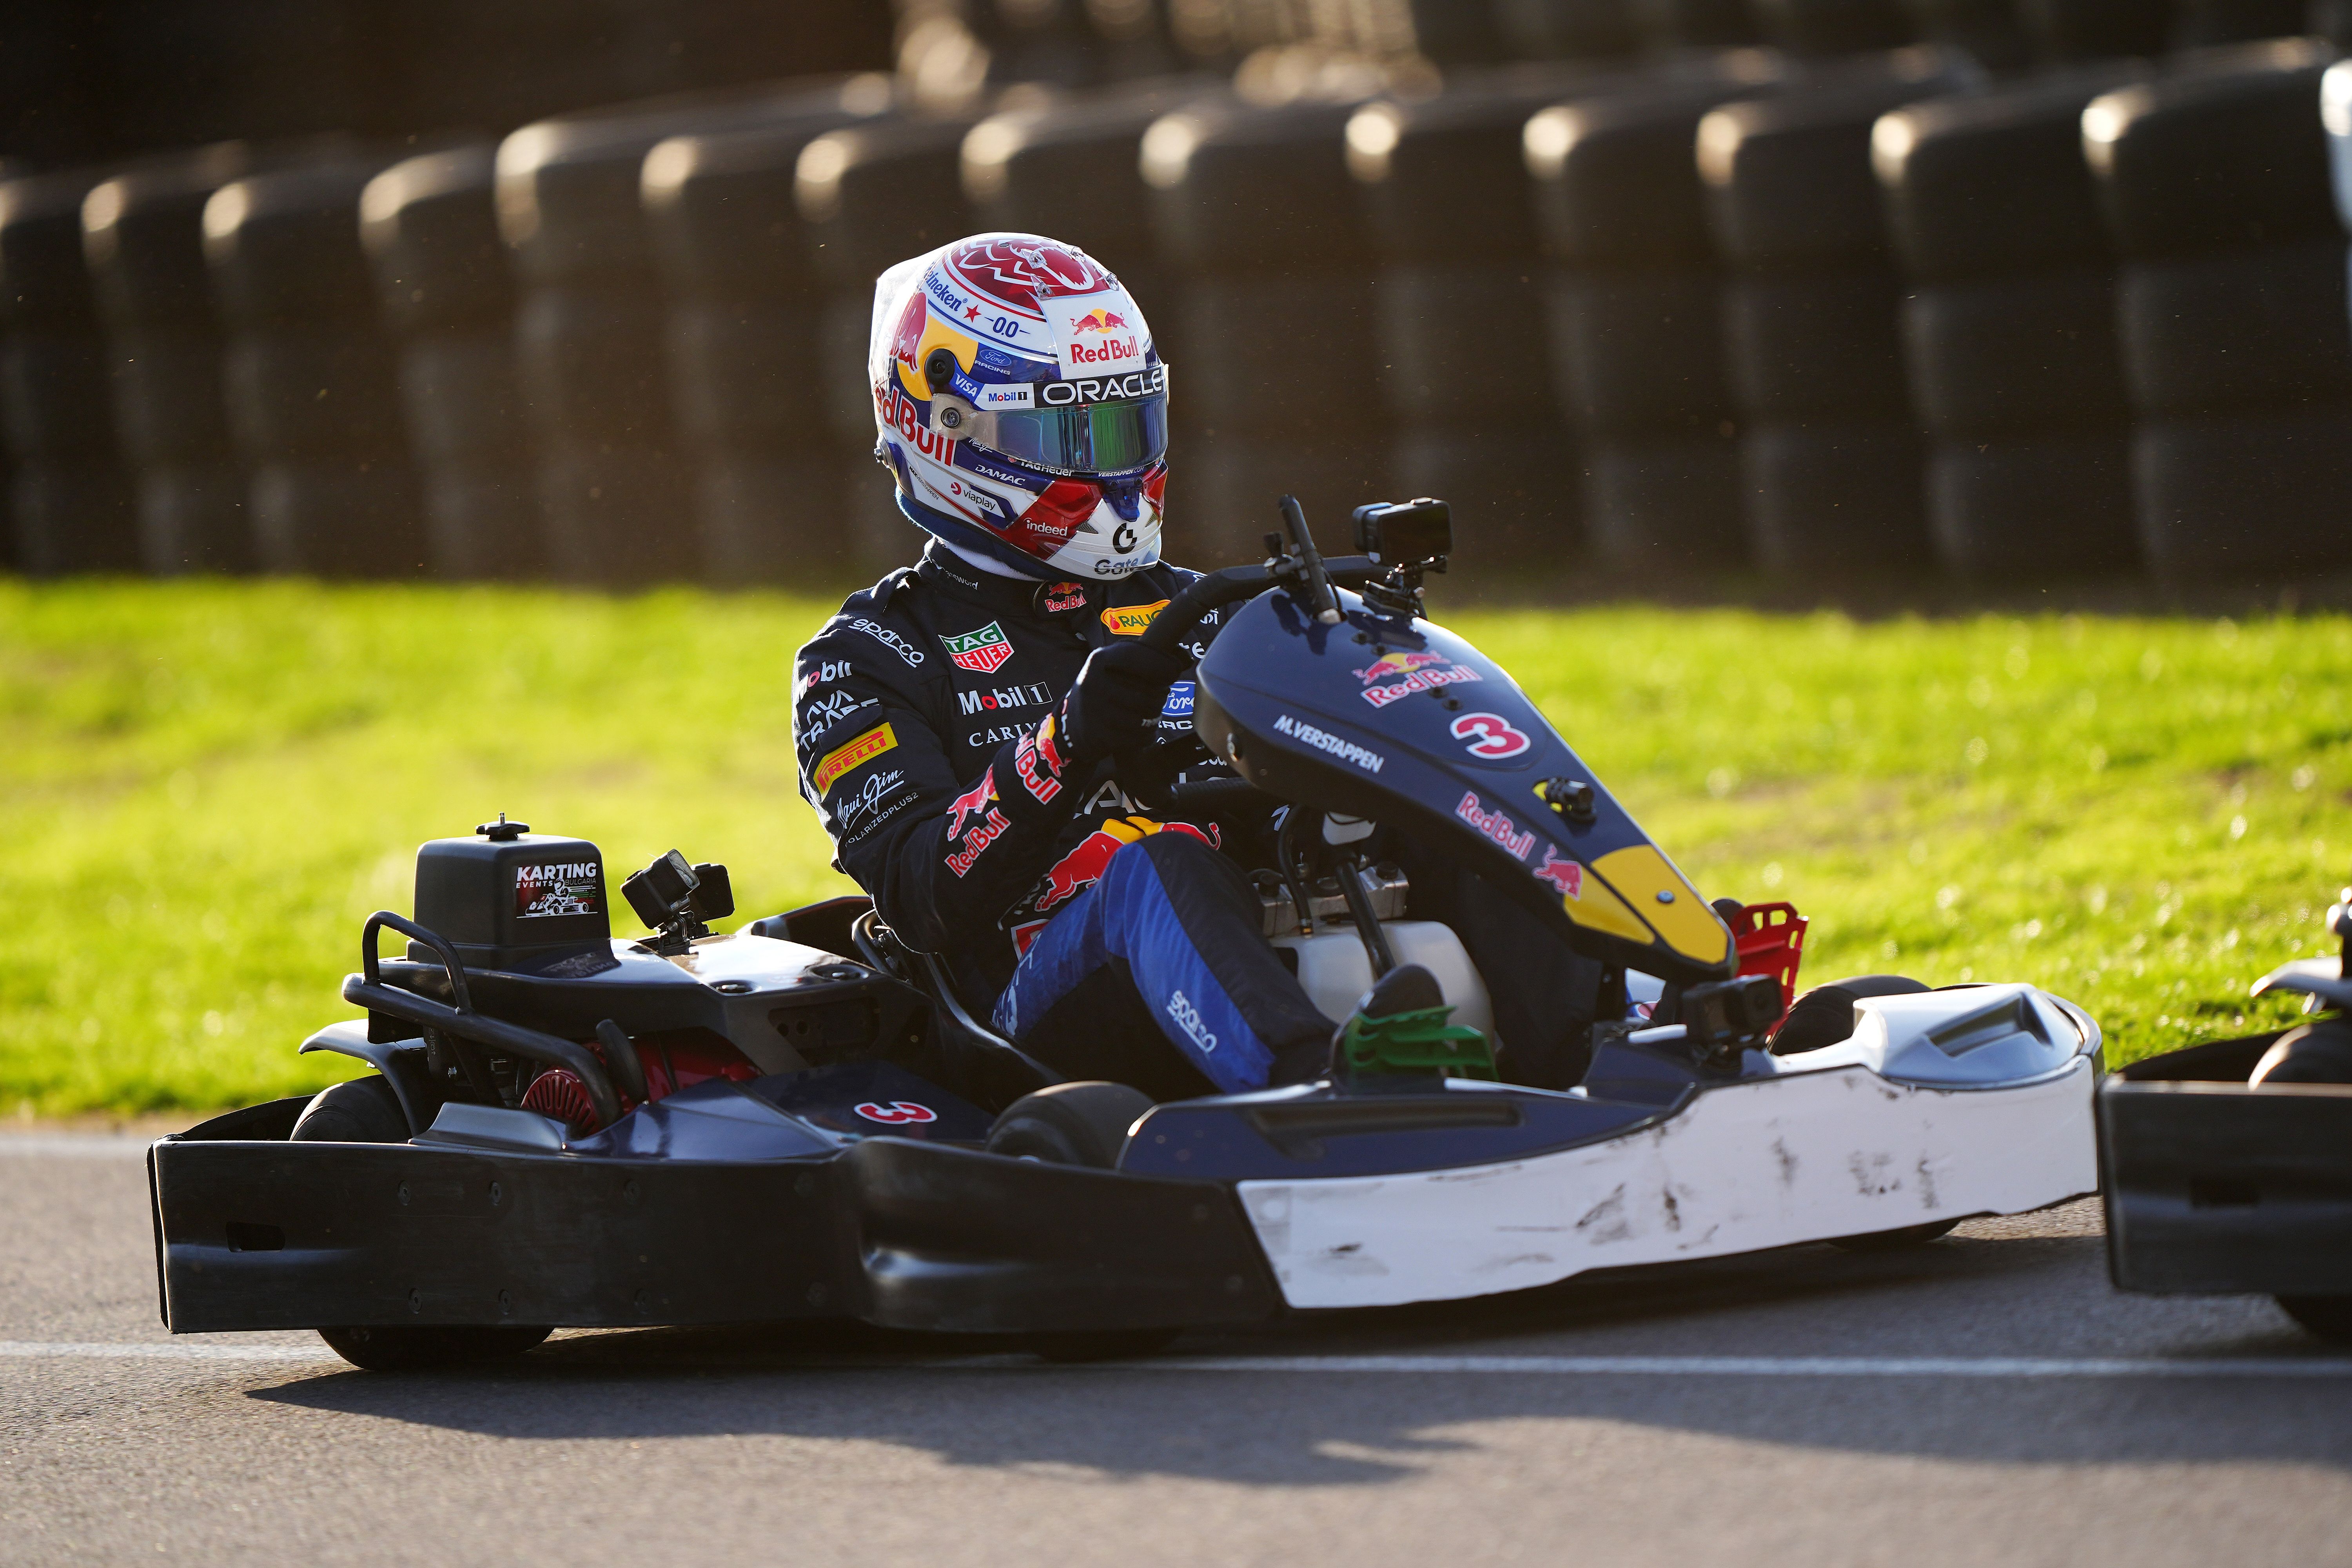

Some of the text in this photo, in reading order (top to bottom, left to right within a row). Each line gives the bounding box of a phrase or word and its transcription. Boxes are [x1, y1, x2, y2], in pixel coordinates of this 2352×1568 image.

[922, 267, 962, 312] eineken
[985, 351, 1006, 364] Ford
[1071, 336, 1139, 363] Red Bull
[975, 360, 1011, 375] RACING
[955, 373, 978, 397] VISA
[989, 392, 1016, 402] Mobil
[1043, 369, 1162, 405] ORACLE
[900, 397, 955, 467] Bull
[975, 465, 1026, 486] DAMAC
[1098, 466, 1145, 477] VERSTAPPEN.COM
[964, 490, 996, 511] viaplay
[1026, 519, 1068, 536] indeed
[1045, 597, 1069, 612] Red
[1118, 609, 1164, 627] RAUC
[848, 618, 925, 668] sparco
[944, 629, 999, 652] TAG
[953, 644, 1009, 670] HEUER
[958, 685, 1046, 715] Mobil 1
[1451, 712, 1530, 759] 3
[817, 731, 887, 791] PIRELLI
[1016, 748, 1063, 805] Bull
[837, 770, 904, 829] Maui Jim
[845, 792, 918, 848] OLARIZEDPLUS2
[1455, 791, 1536, 861] Red Bull
[945, 808, 1011, 877] Red Bull
[516, 880, 553, 889] EVENTS
[517, 862, 597, 882] KARTING
[854, 1101, 937, 1124] 3
